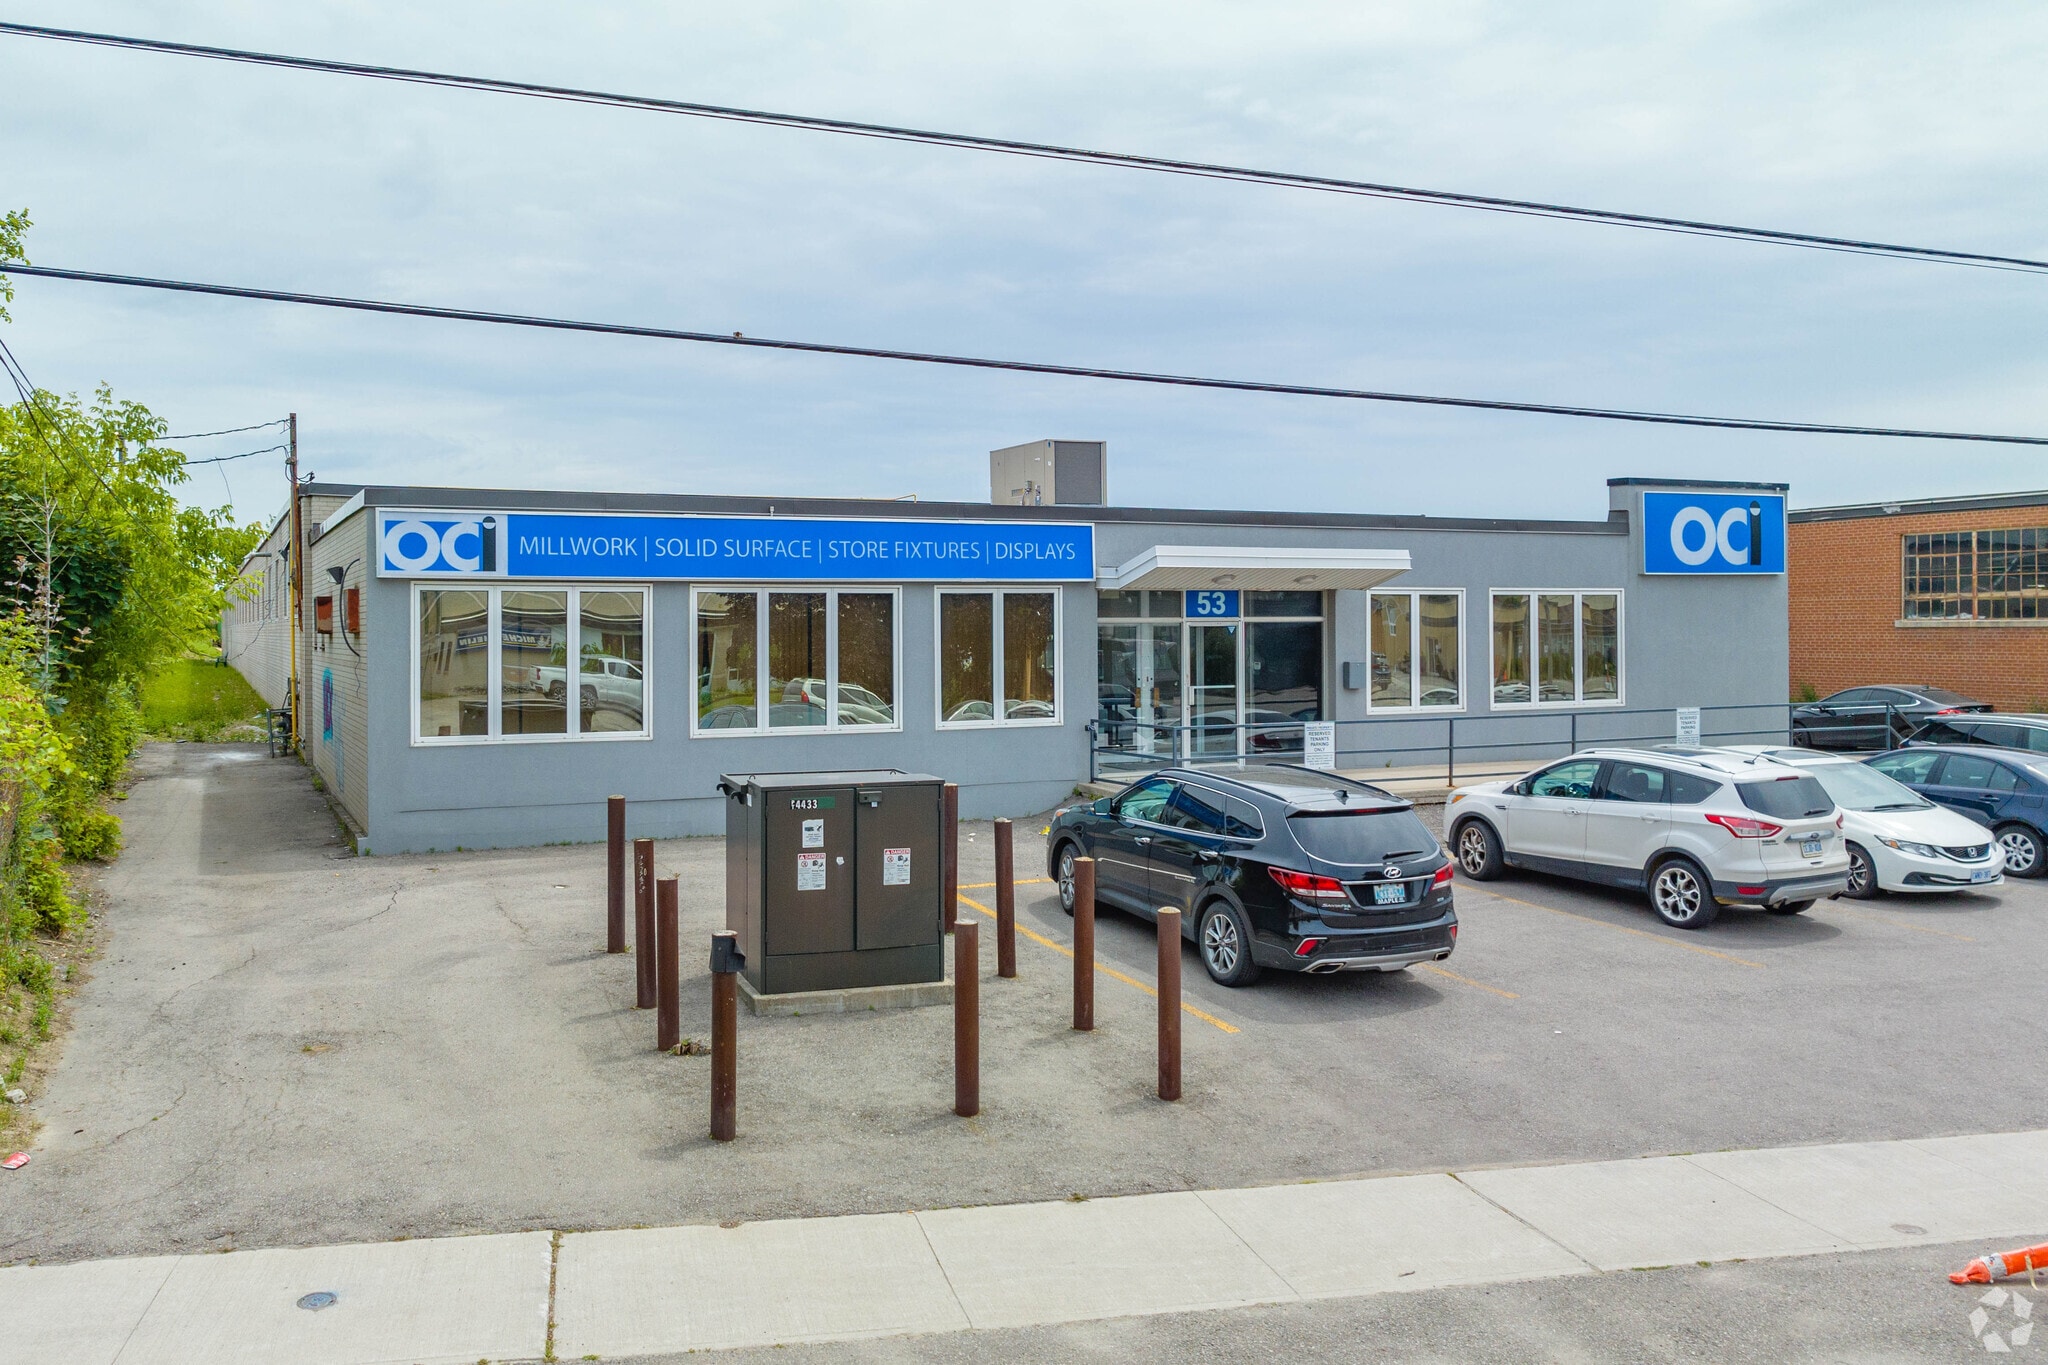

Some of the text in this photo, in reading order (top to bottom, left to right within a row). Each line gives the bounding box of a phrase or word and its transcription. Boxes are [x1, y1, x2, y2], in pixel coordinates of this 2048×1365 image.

[519, 536, 1076, 560] MILLWORK SOLID SURFACE STORE FIXTURES DISPLAYS
[1197, 591, 1226, 615] 53
